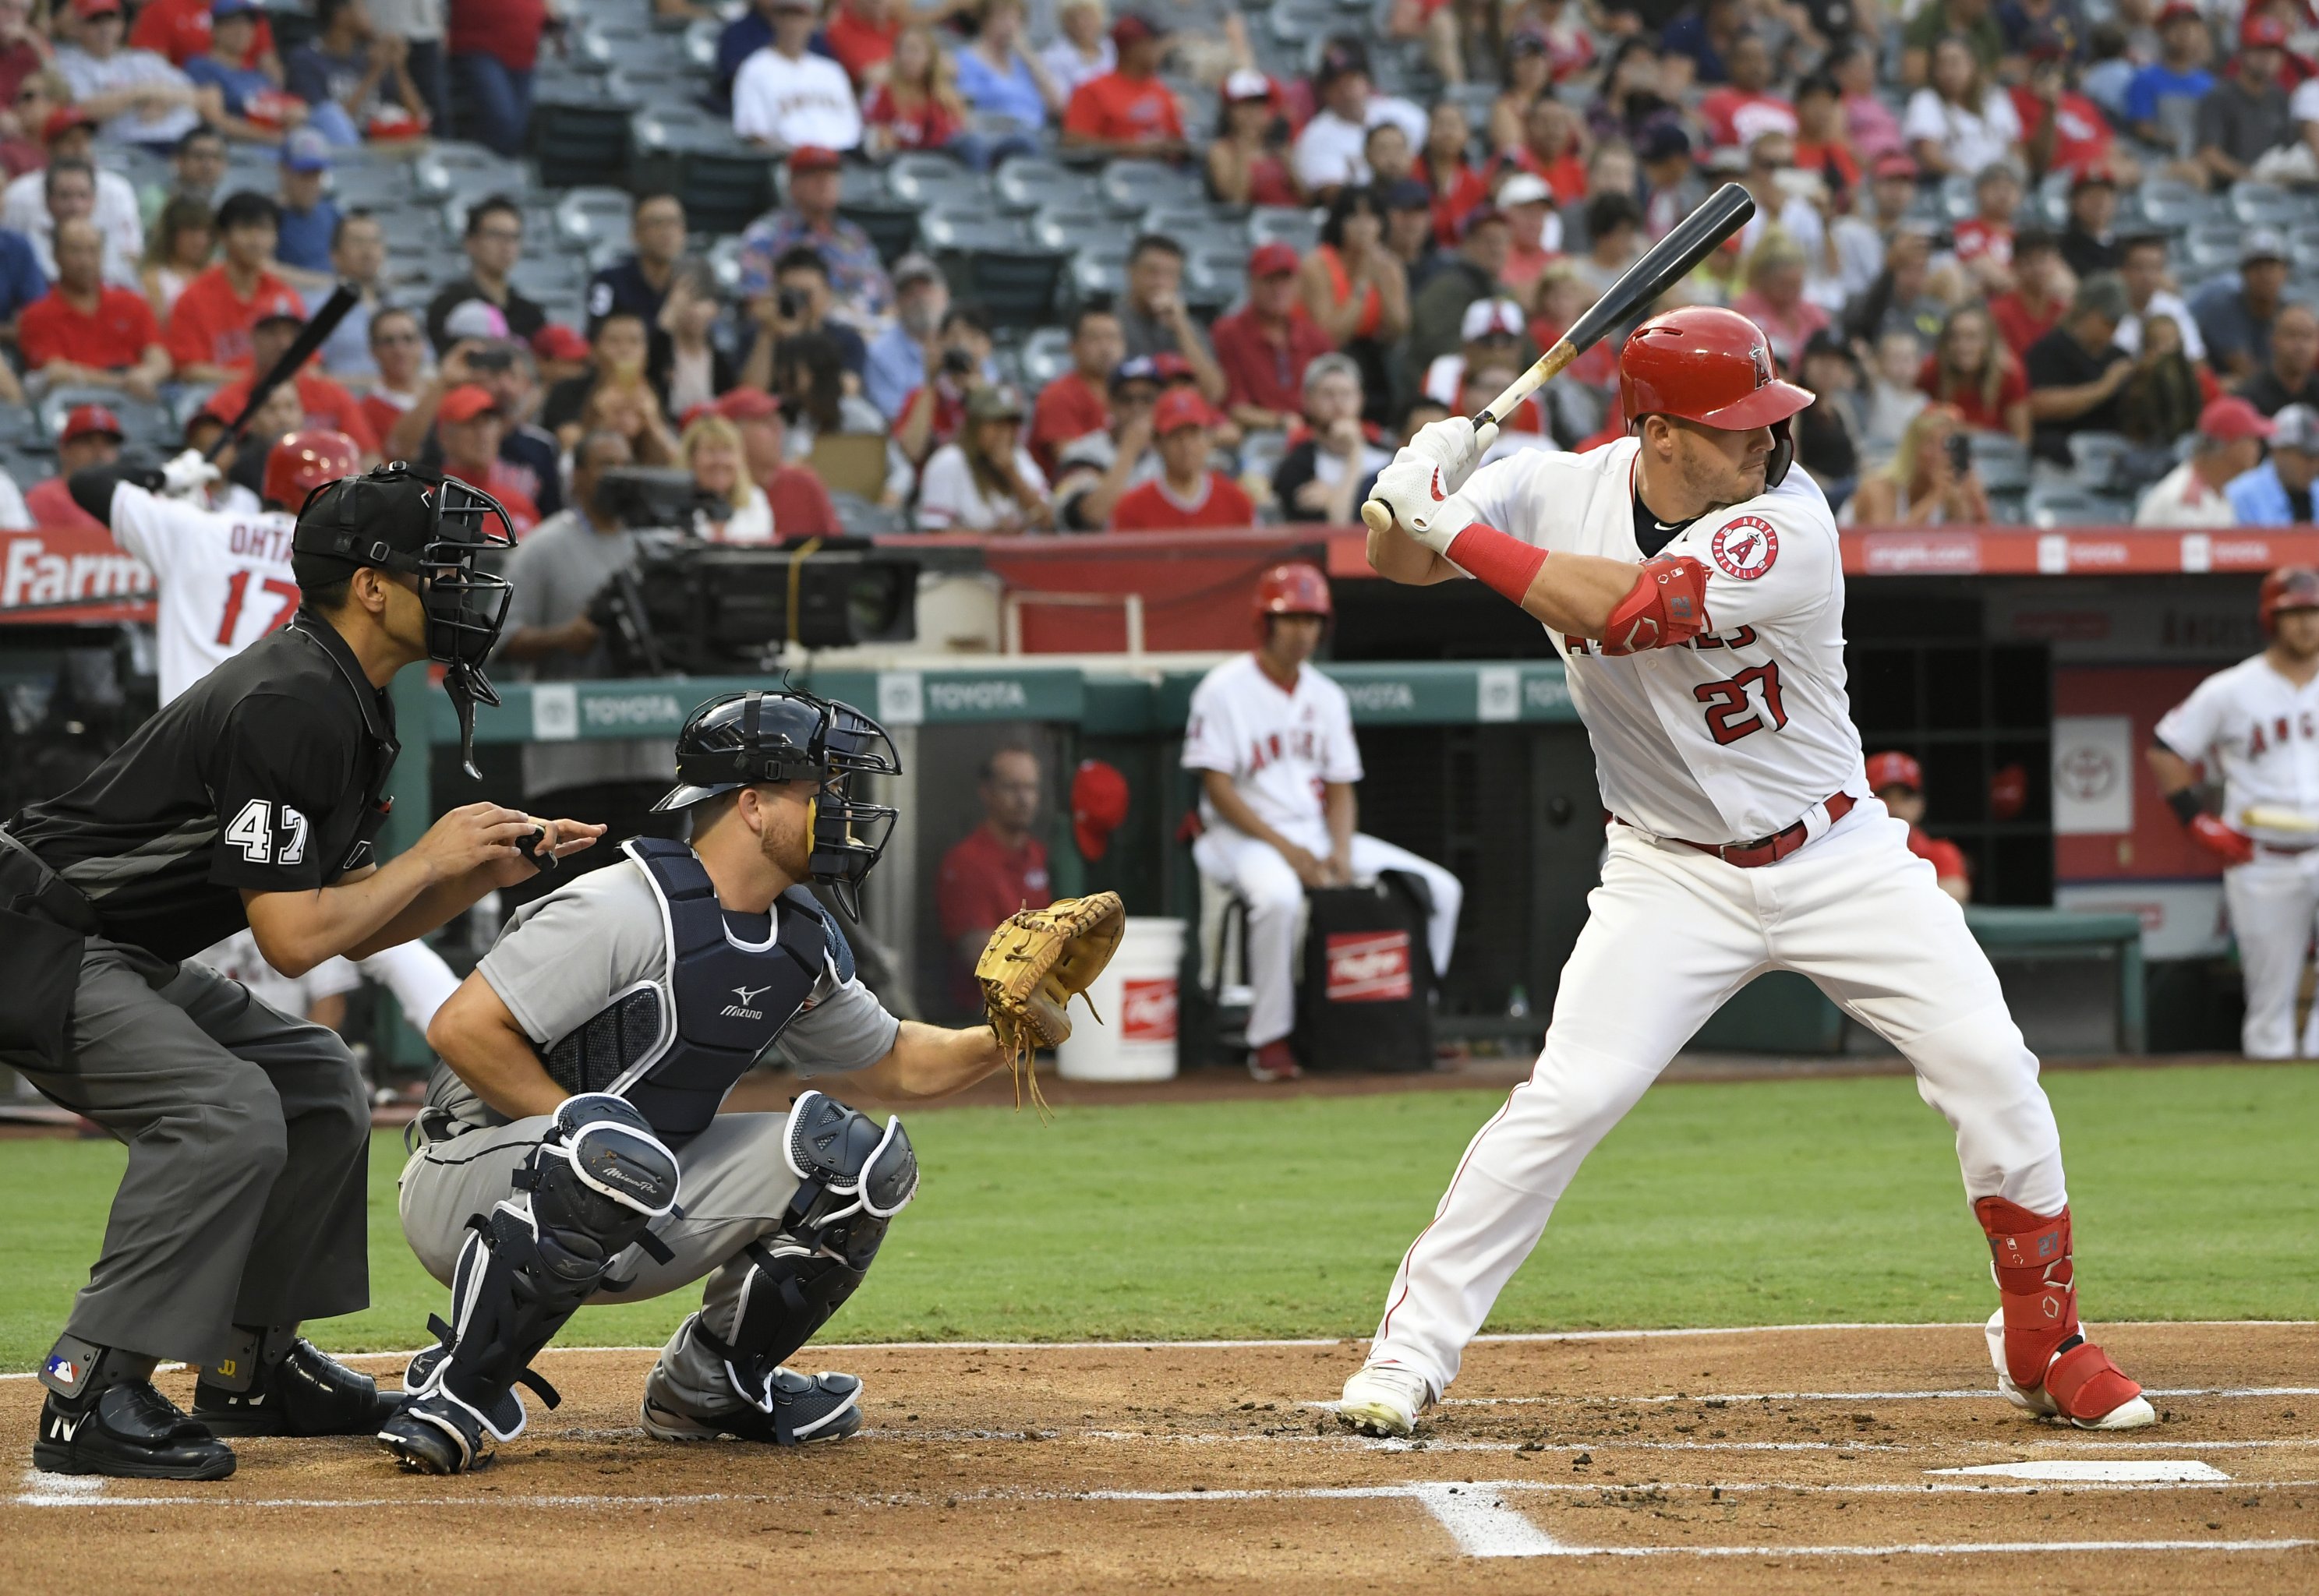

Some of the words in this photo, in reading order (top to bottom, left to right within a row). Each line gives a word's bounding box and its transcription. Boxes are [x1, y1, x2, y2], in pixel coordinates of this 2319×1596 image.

[1742, 517, 1776, 550] ANGELS
[2, 538, 152, 608] Farm
[1713, 537, 1755, 578] BASEBALL
[216, 569, 300, 646] 17
[1670, 596, 1692, 619] 27
[584, 696, 682, 725] TOYOTA
[928, 682, 1026, 710] TOYOTA
[1693, 659, 1789, 746] 27
[224, 798, 309, 865] 47
[719, 1005, 763, 1020] MIZUNO
[2038, 1231, 2059, 1258] 27
